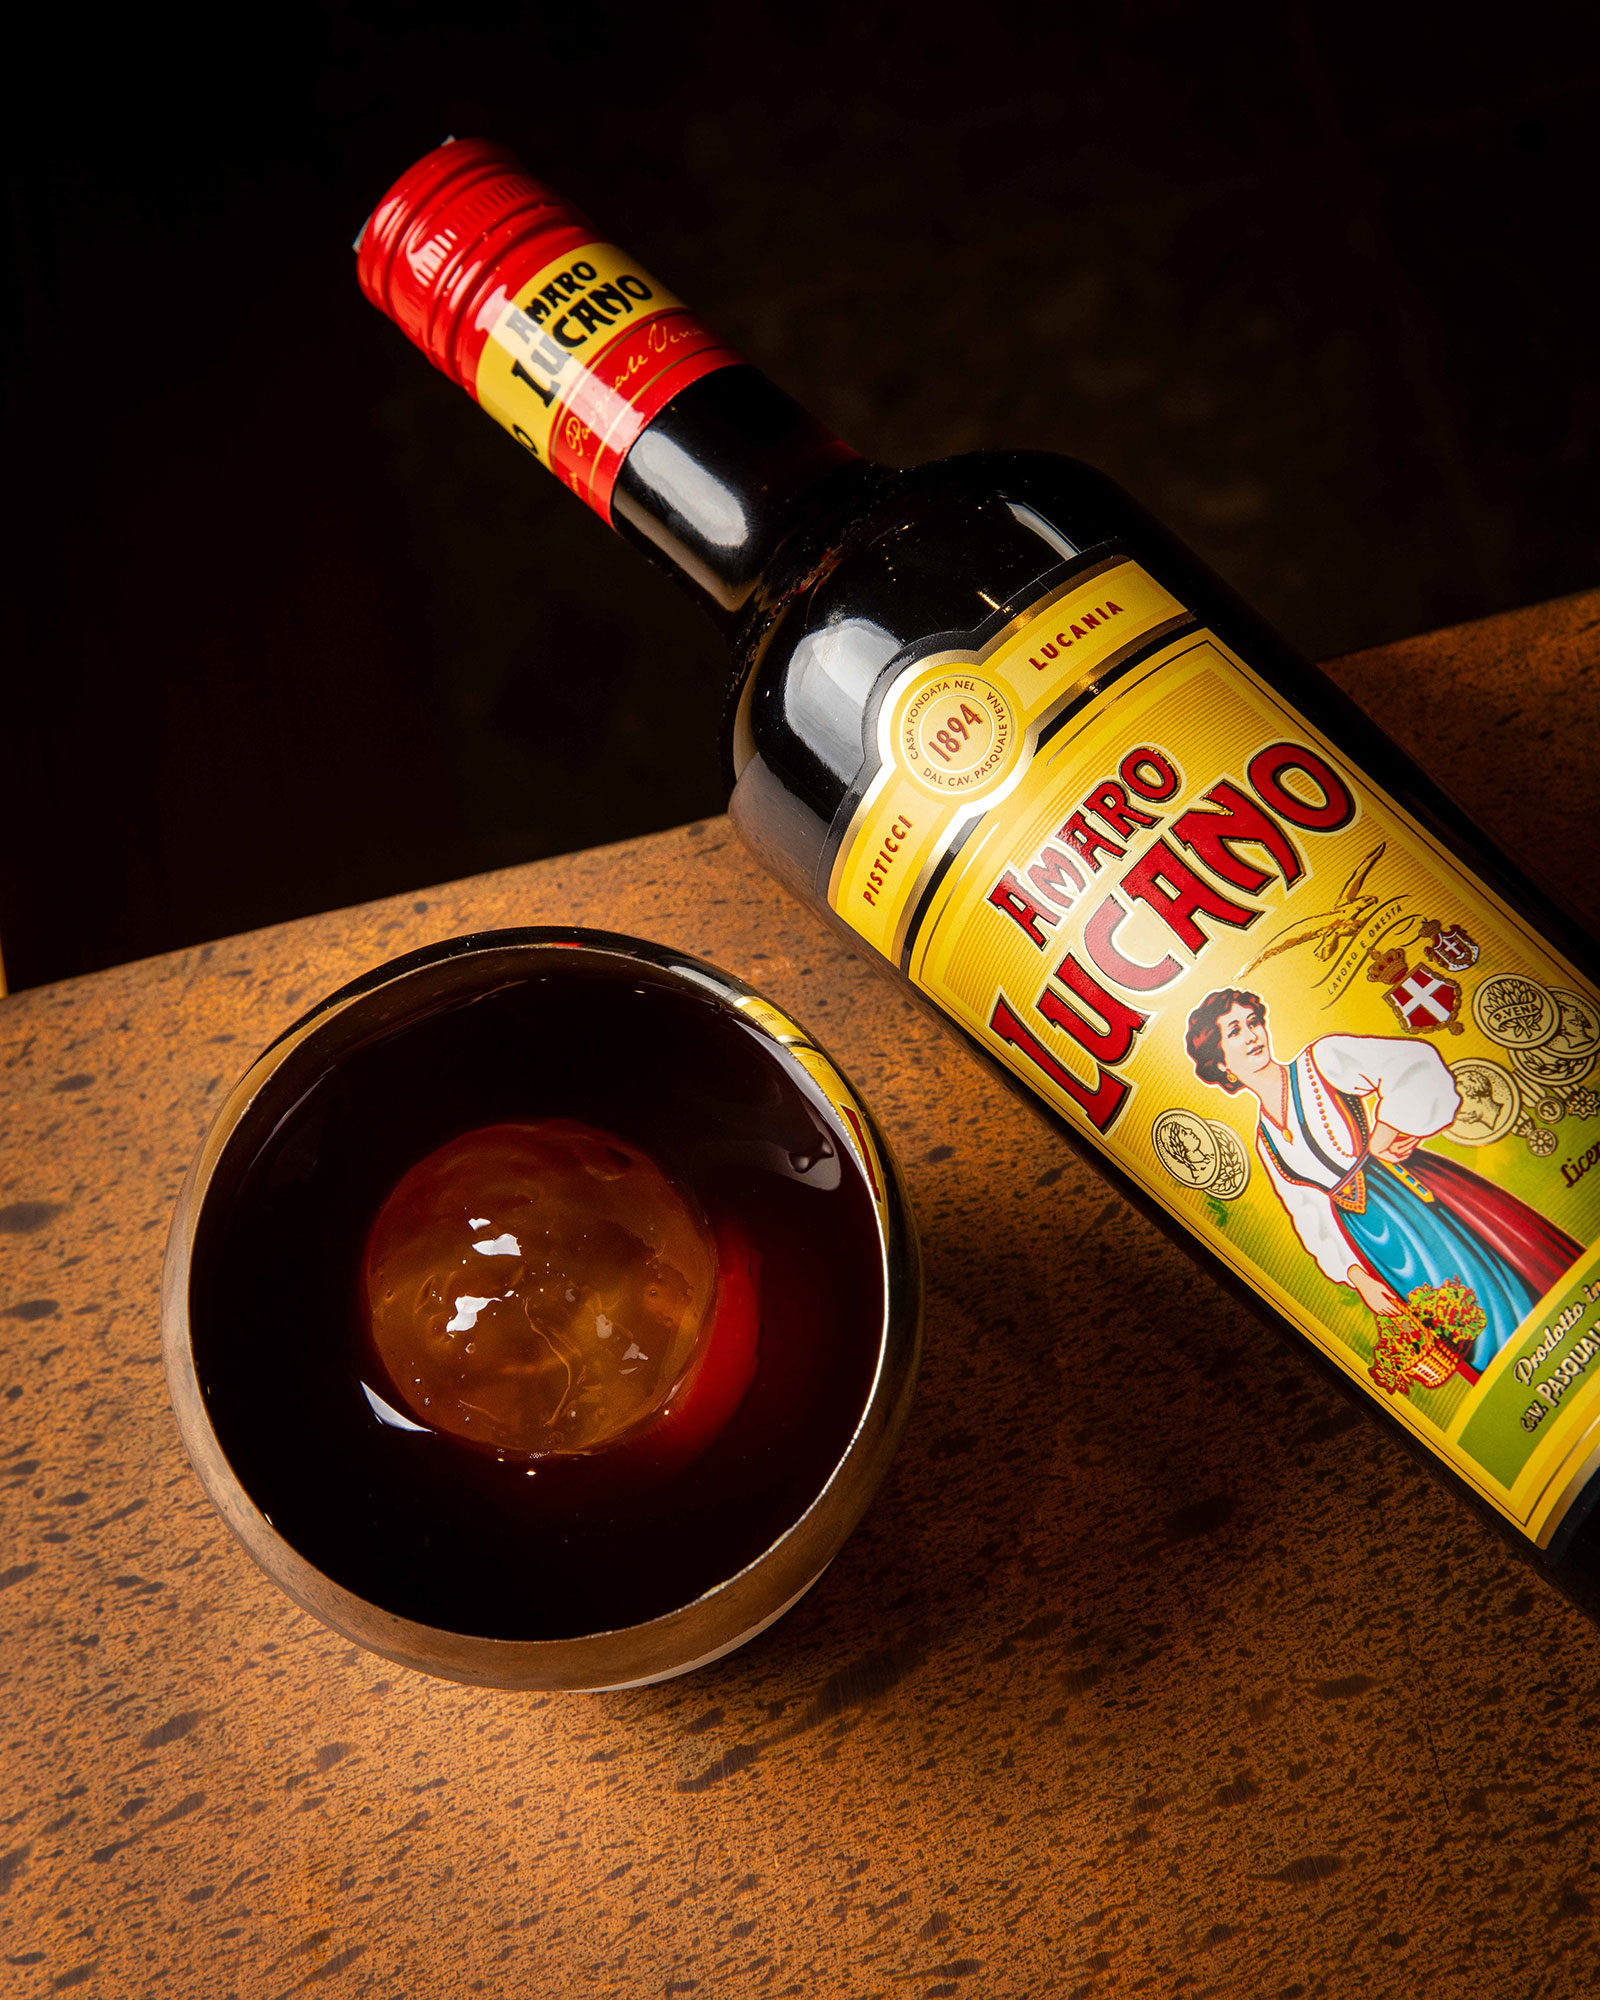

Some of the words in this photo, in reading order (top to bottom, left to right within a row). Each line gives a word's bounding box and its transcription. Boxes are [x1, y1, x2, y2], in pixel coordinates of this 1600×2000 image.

[506, 261, 597, 344] AMARO
[511, 275, 653, 408] LUCANO
[1028, 600, 1124, 672] LUCANIA
[908, 682, 950, 724] FONDATA
[954, 680, 975, 691] NEL
[986, 692, 1006, 722] VENA
[905, 729, 919, 760] CASA
[928, 703, 983, 762] 1894
[974, 724, 1008, 779] PASQUALE
[923, 767, 943, 785] DAL
[948, 775, 973, 787] CAV.
[863, 815, 913, 906] PISTICCI
[987, 745, 1182, 952] AMARO
[988, 742, 1358, 1135] LUCANO
[1328, 951, 1357, 995] LAVORO
[1513, 1301, 1587, 1385] Prodotto
[1520, 1400, 1549, 1434] CAV.
